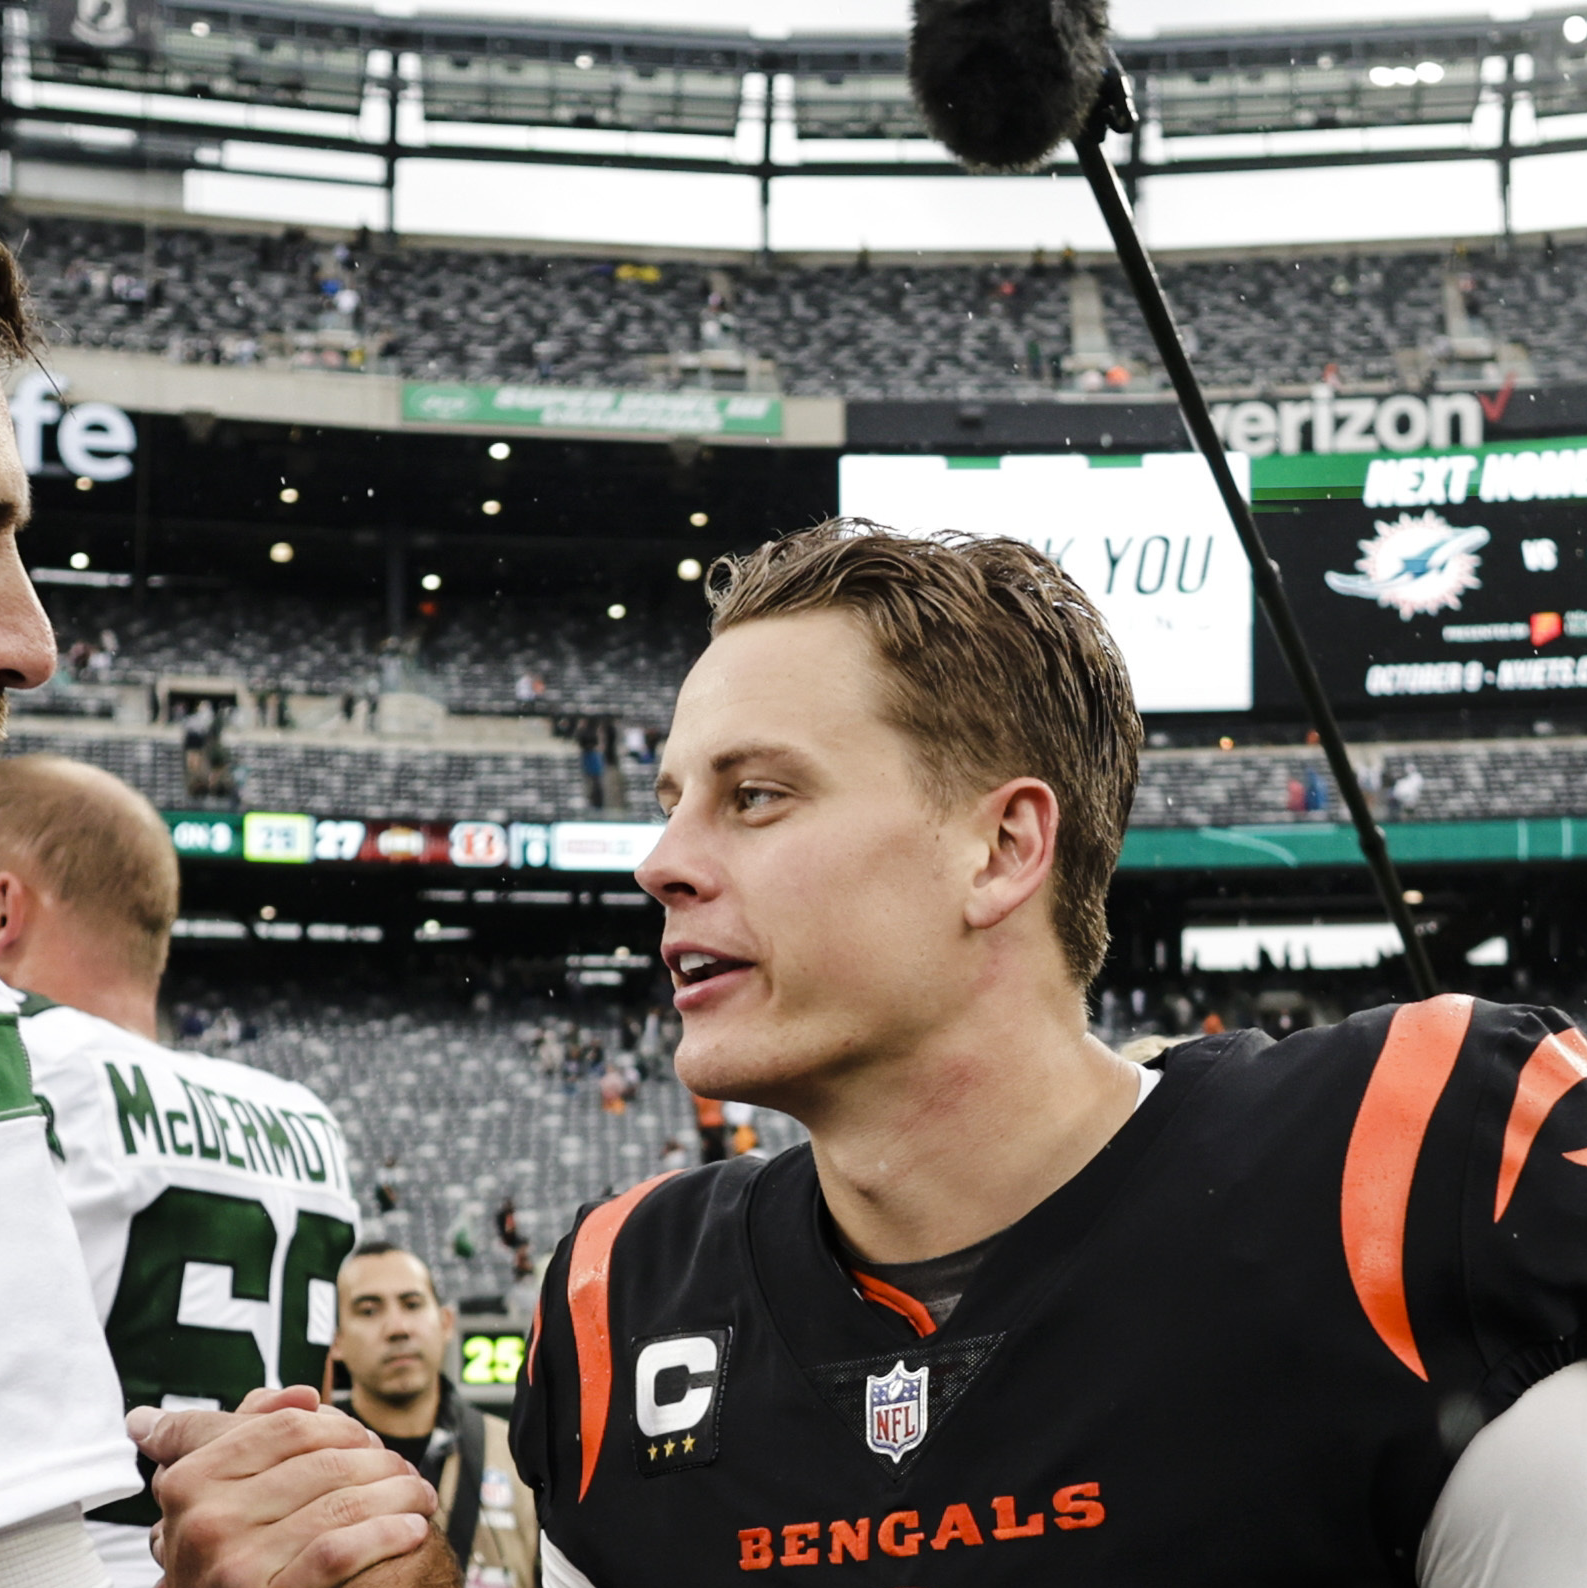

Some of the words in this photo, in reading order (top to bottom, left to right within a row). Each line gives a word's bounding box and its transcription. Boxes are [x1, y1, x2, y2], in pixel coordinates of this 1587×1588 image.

[1363, 454, 1478, 508] NEXT
[1103, 534, 1214, 595] YOU
[1364, 661, 1464, 697] OCTOBER
[314, 819, 367, 861] 27
[462, 1335, 525, 1384] 25
[875, 1405, 916, 1444] NFL
[738, 1481, 1106, 1572] BENGALS
